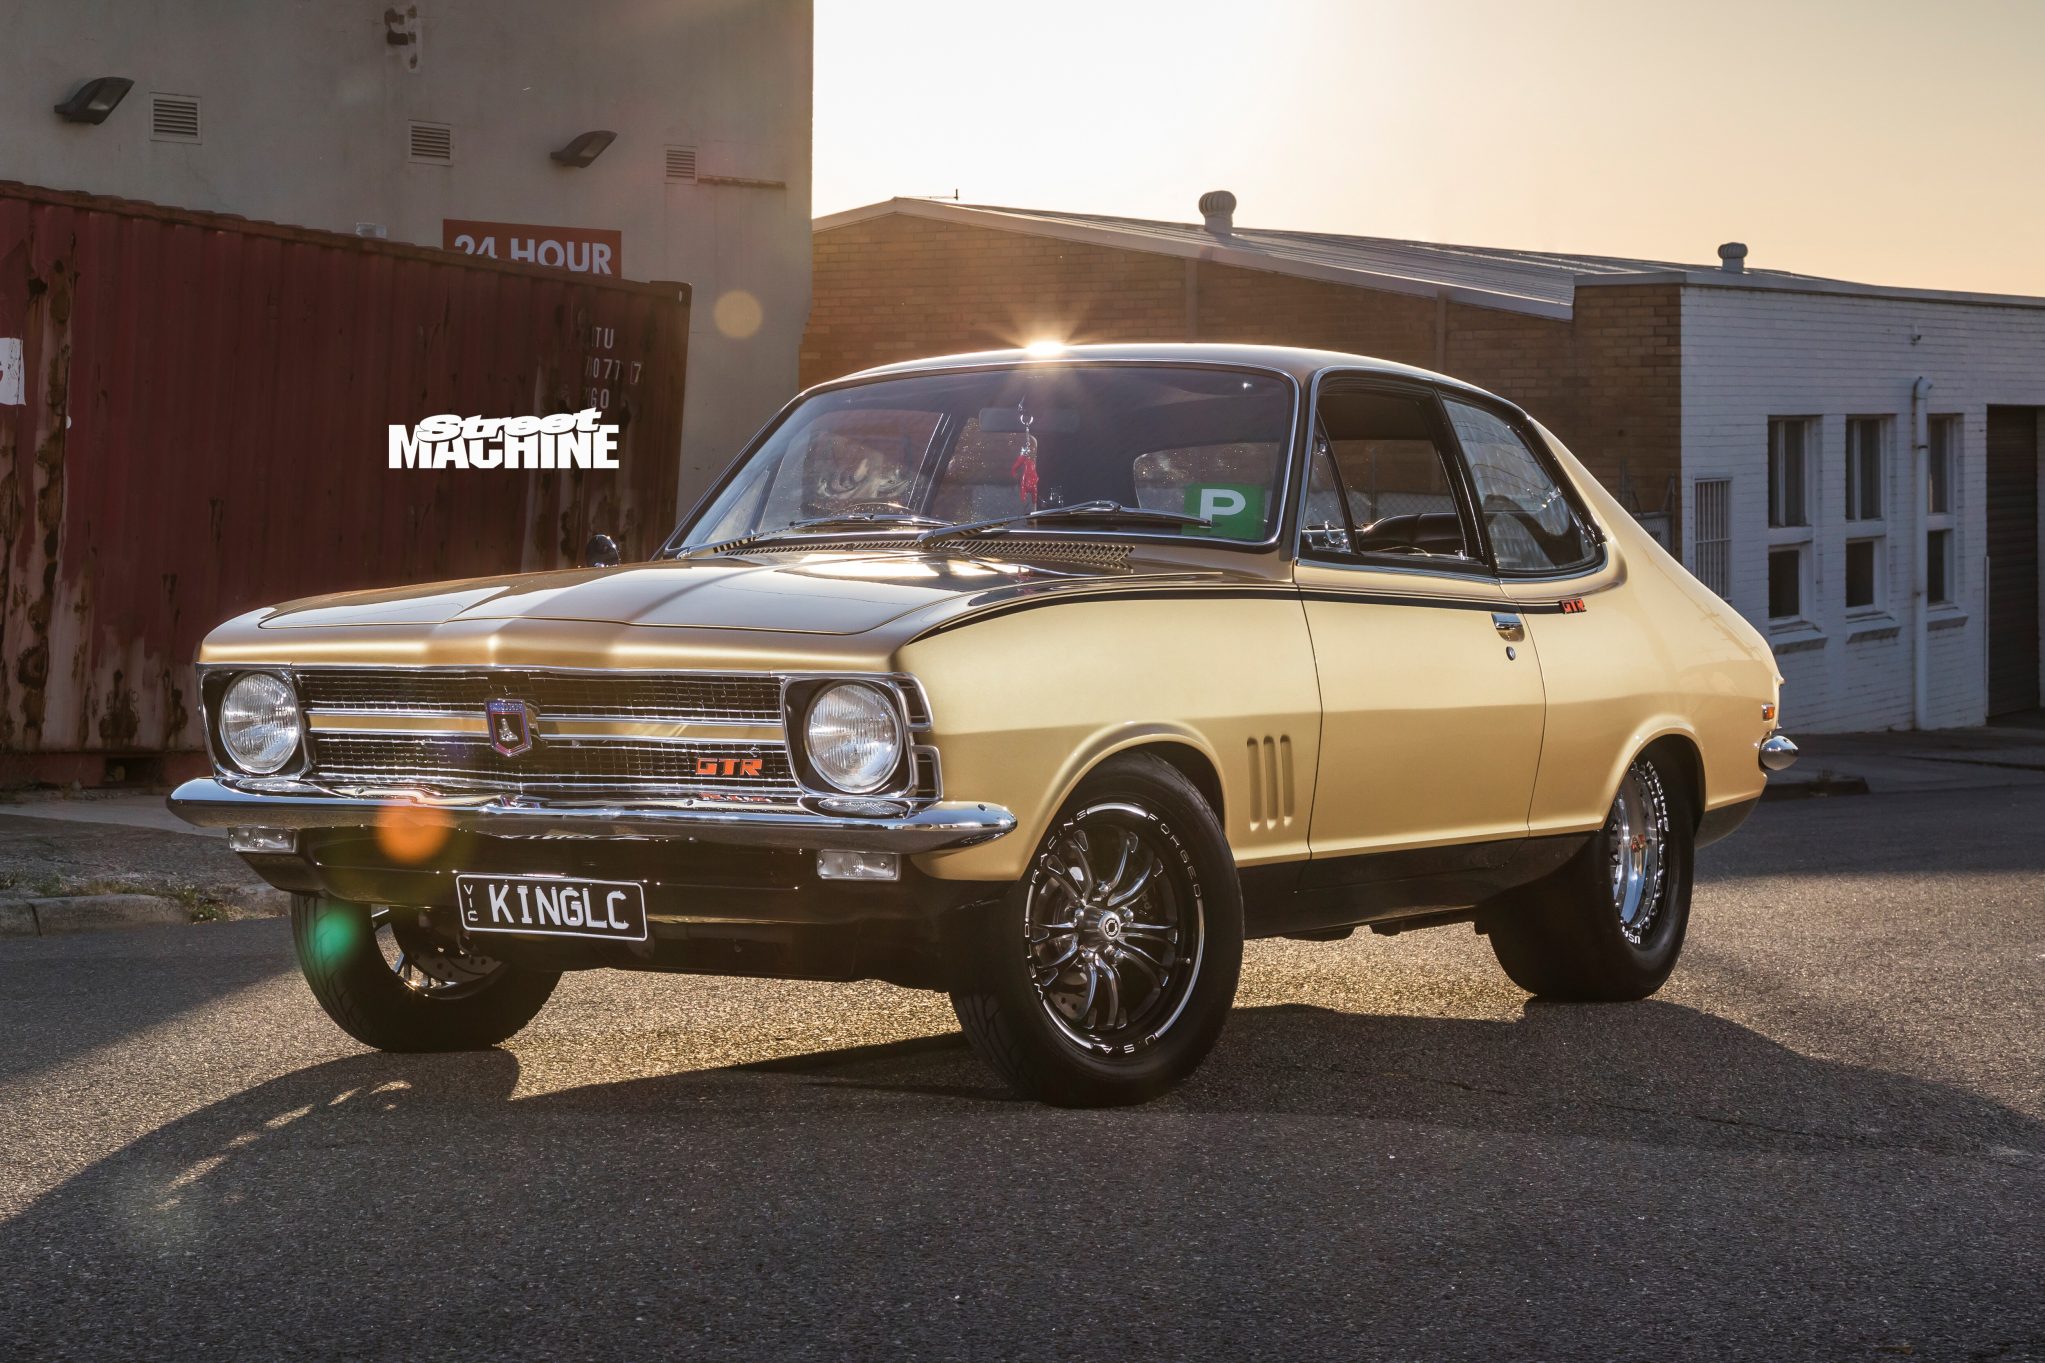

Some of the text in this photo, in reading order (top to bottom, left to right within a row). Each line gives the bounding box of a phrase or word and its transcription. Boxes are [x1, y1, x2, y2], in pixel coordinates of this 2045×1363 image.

[454, 235, 612, 275] 24 HOUR
[1200, 488, 1246, 529] P
[1562, 599, 1586, 613] GTR
[695, 758, 763, 776] GTR
[1031, 809, 1087, 884] RACING
[1147, 812, 1201, 898] FORGED
[463, 884, 478, 921] VIC
[488, 884, 630, 930] KINGLC
